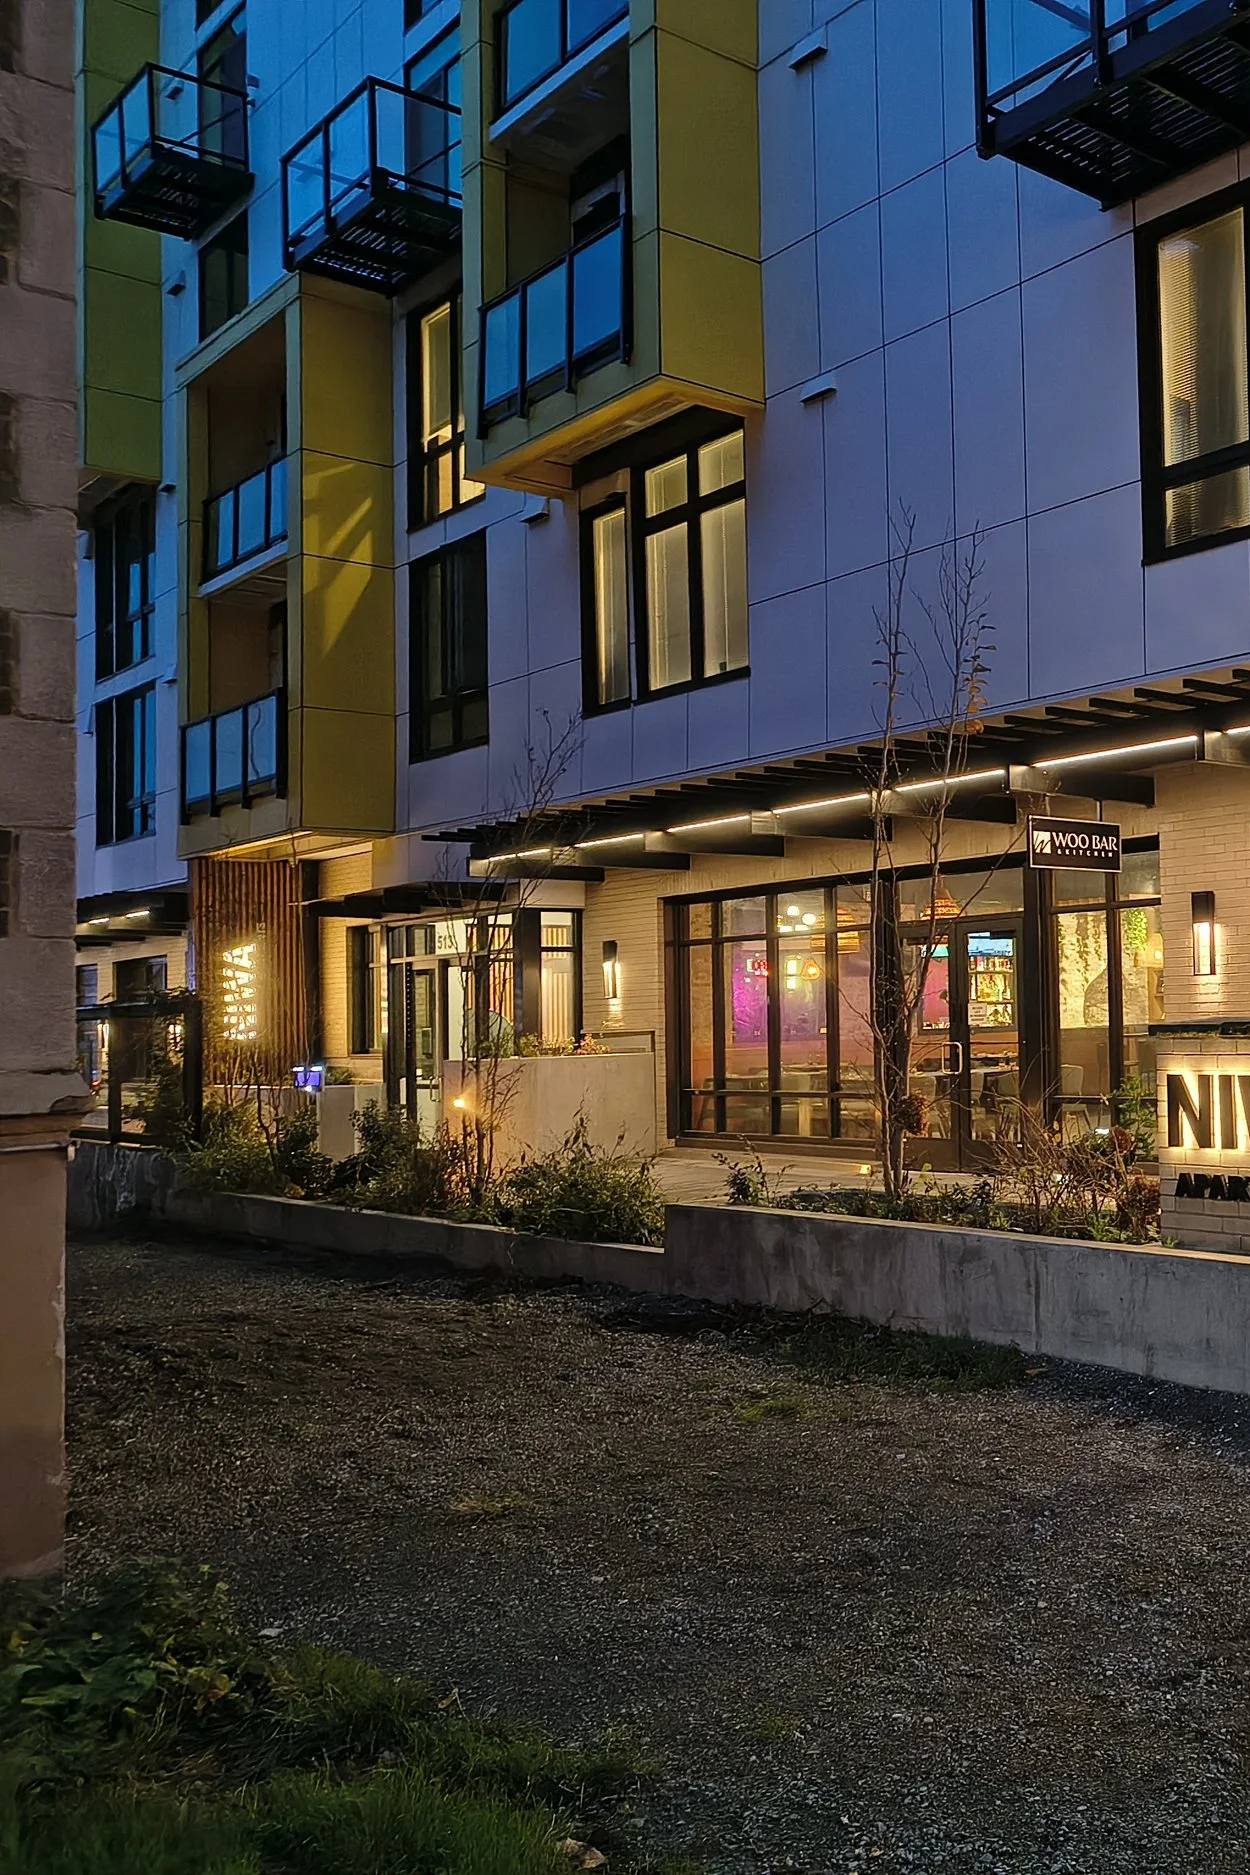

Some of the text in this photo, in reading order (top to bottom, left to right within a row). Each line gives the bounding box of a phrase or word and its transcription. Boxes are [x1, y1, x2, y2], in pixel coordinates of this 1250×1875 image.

[1052, 832, 1118, 851] WOO BAR
[437, 934, 453, 950] 513
[222, 943, 257, 1041] NIWA
